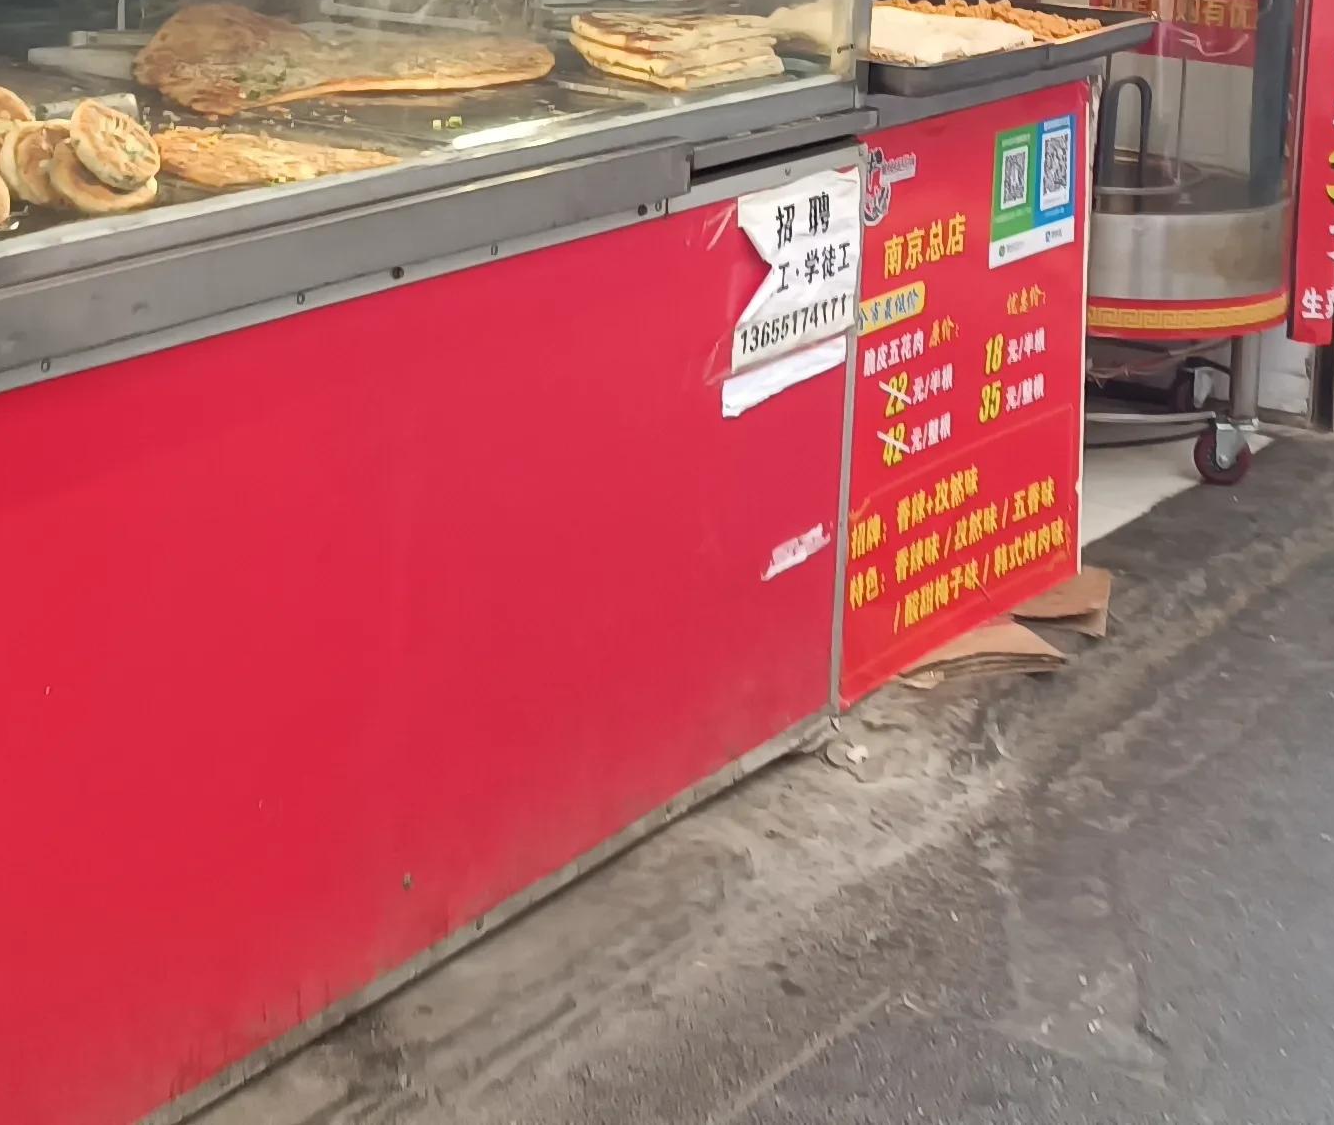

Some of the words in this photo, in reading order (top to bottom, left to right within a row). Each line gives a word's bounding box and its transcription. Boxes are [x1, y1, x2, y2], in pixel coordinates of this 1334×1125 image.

[884, 212, 966, 279] 南京总店
[985, 334, 1003, 374] 18
